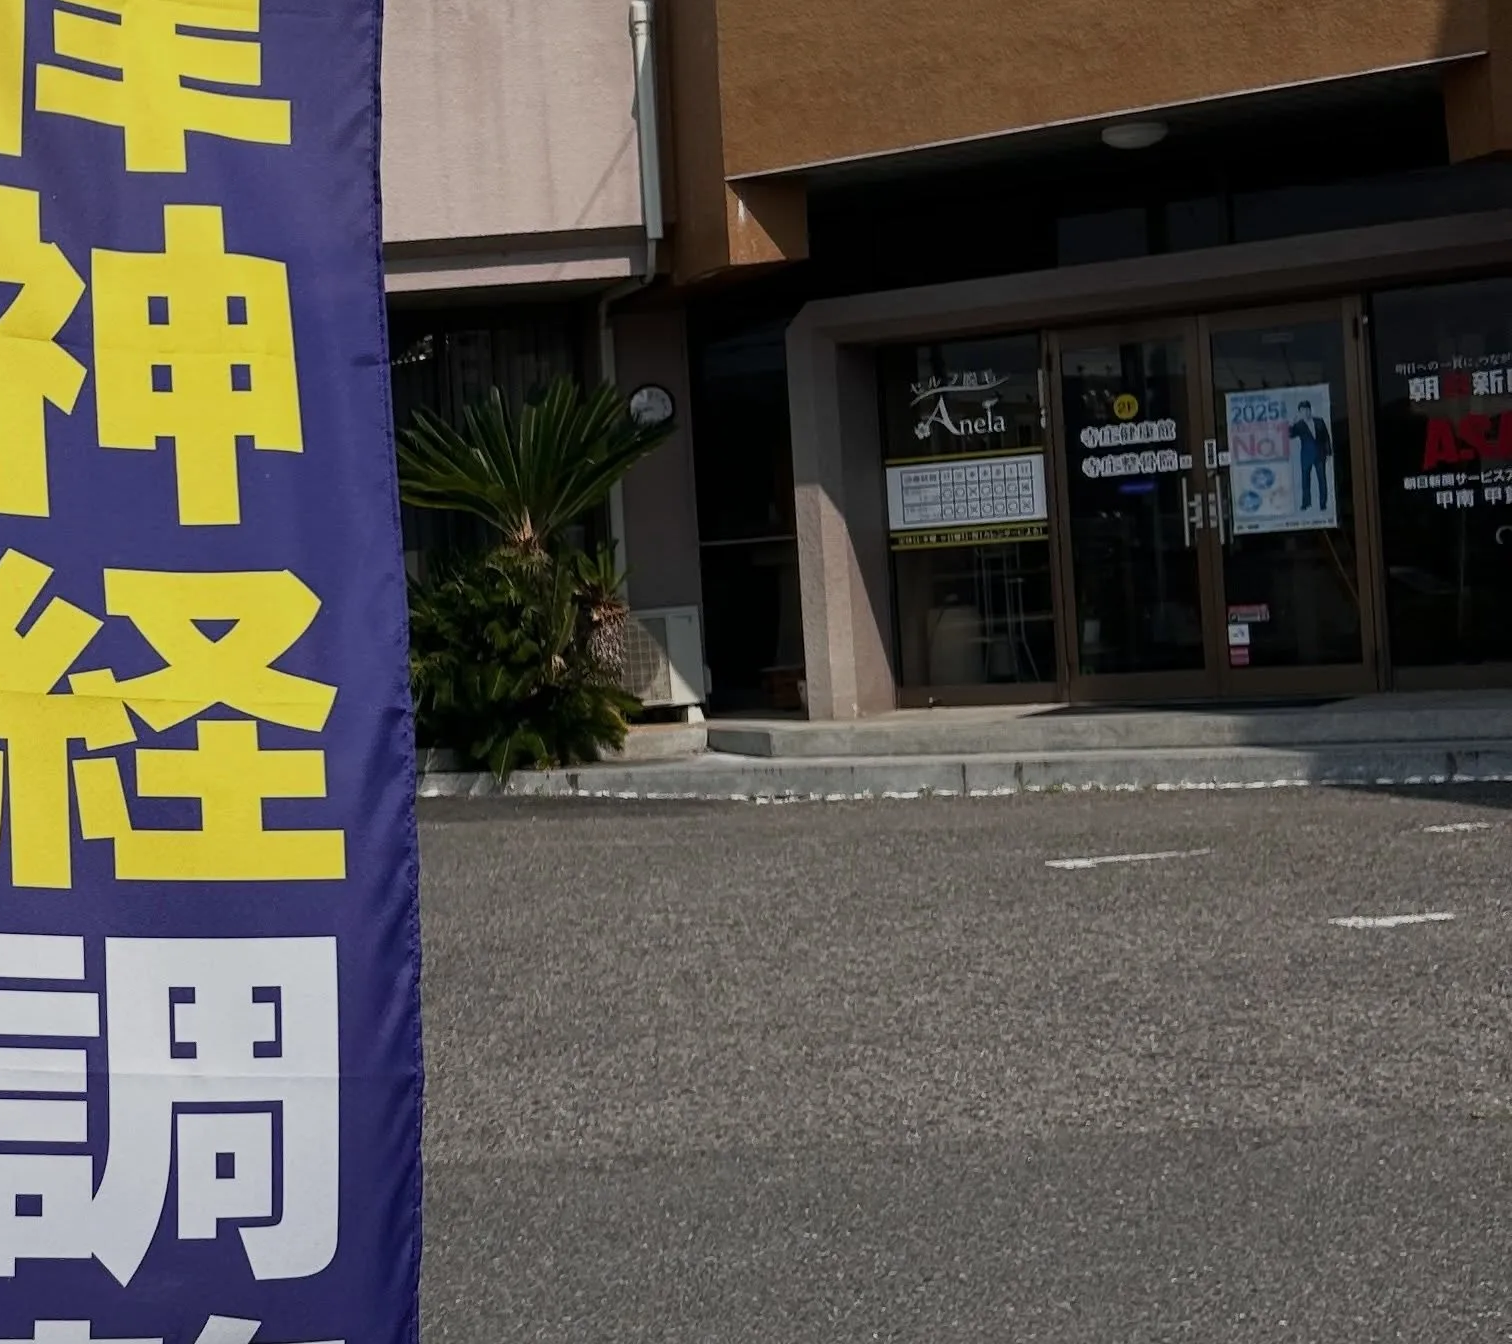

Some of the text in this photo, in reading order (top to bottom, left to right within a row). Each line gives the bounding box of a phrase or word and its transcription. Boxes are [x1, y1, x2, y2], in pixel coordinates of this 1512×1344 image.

[1407, 368, 1512, 402] 朝日新
[925, 395, 1006, 436] Anela
